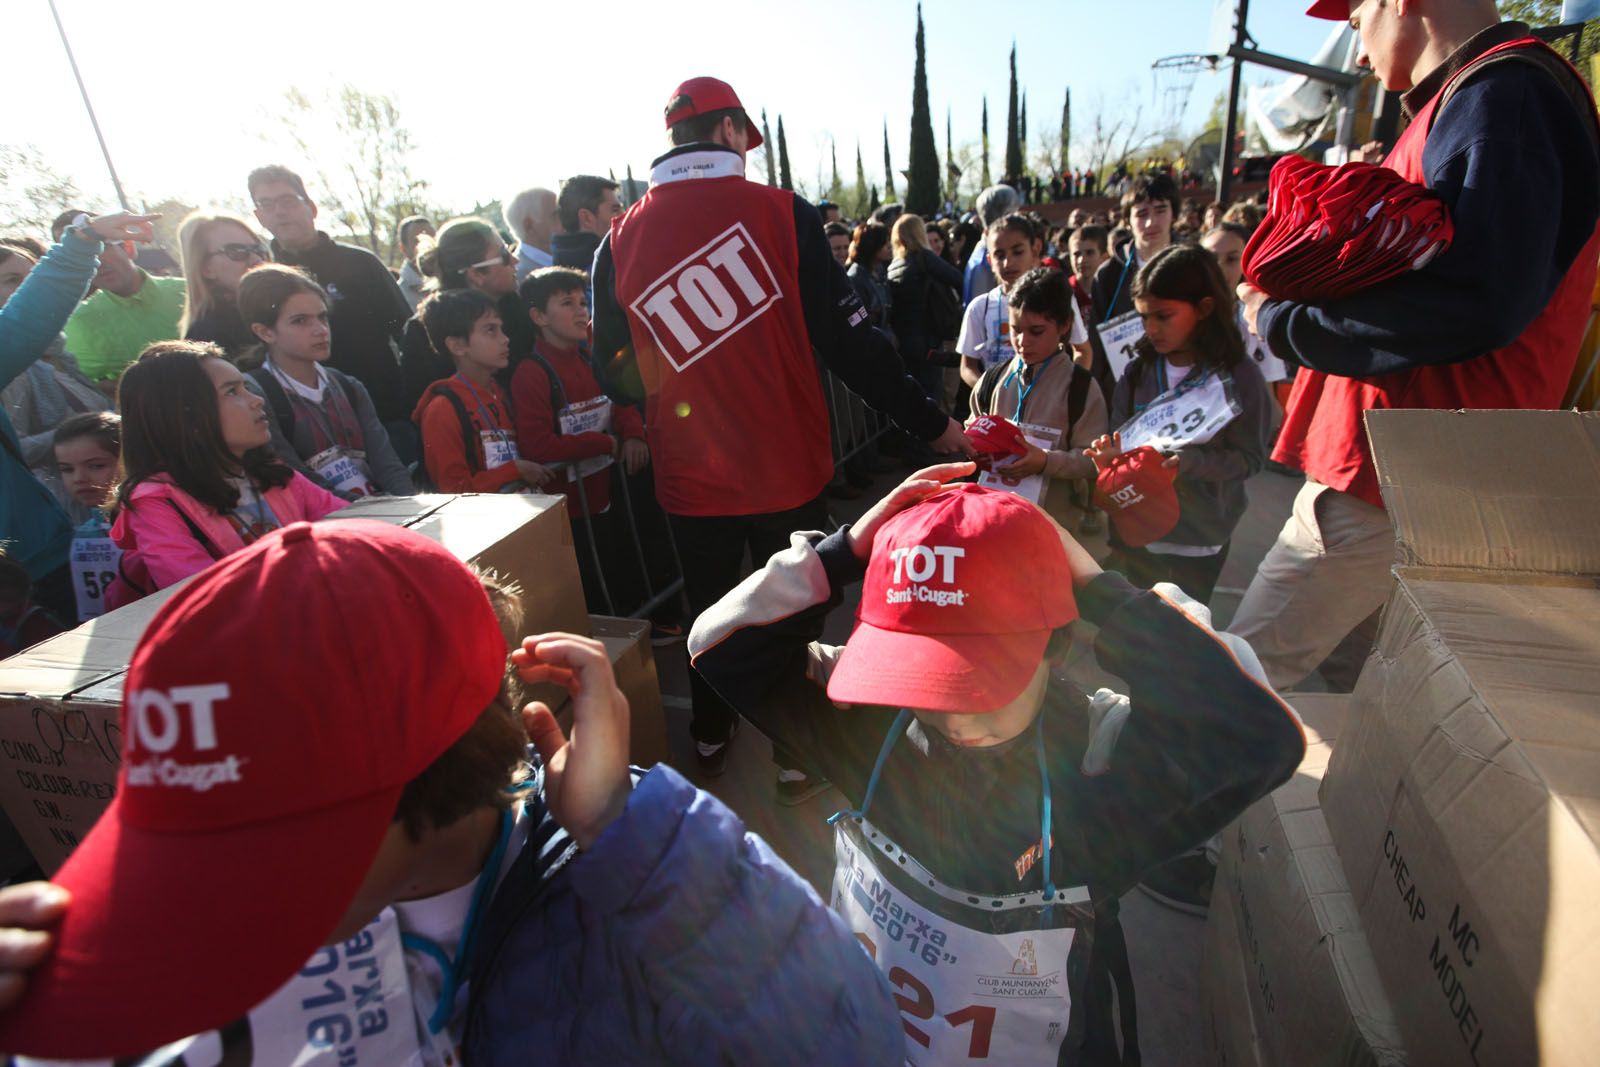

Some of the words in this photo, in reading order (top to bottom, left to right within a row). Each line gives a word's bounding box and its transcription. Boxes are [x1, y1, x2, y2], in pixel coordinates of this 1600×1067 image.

[643, 235, 767, 353] TOT
[1109, 484, 1137, 503] TOT
[890, 545, 965, 585] TOT
[886, 588, 912, 604] Sant
[919, 585, 964, 607] Cugat
[869, 878, 947, 948] Marxa
[1448, 903, 1480, 967] MC
[1384, 830, 1426, 923] CHEAP
[1429, 935, 1484, 1067] MODEL
[344, 915, 389, 1039] arxa
[977, 977, 1000, 987] CLUB
[992, 987, 1015, 996] SANT
[1017, 987, 1048, 997] CUGAT
